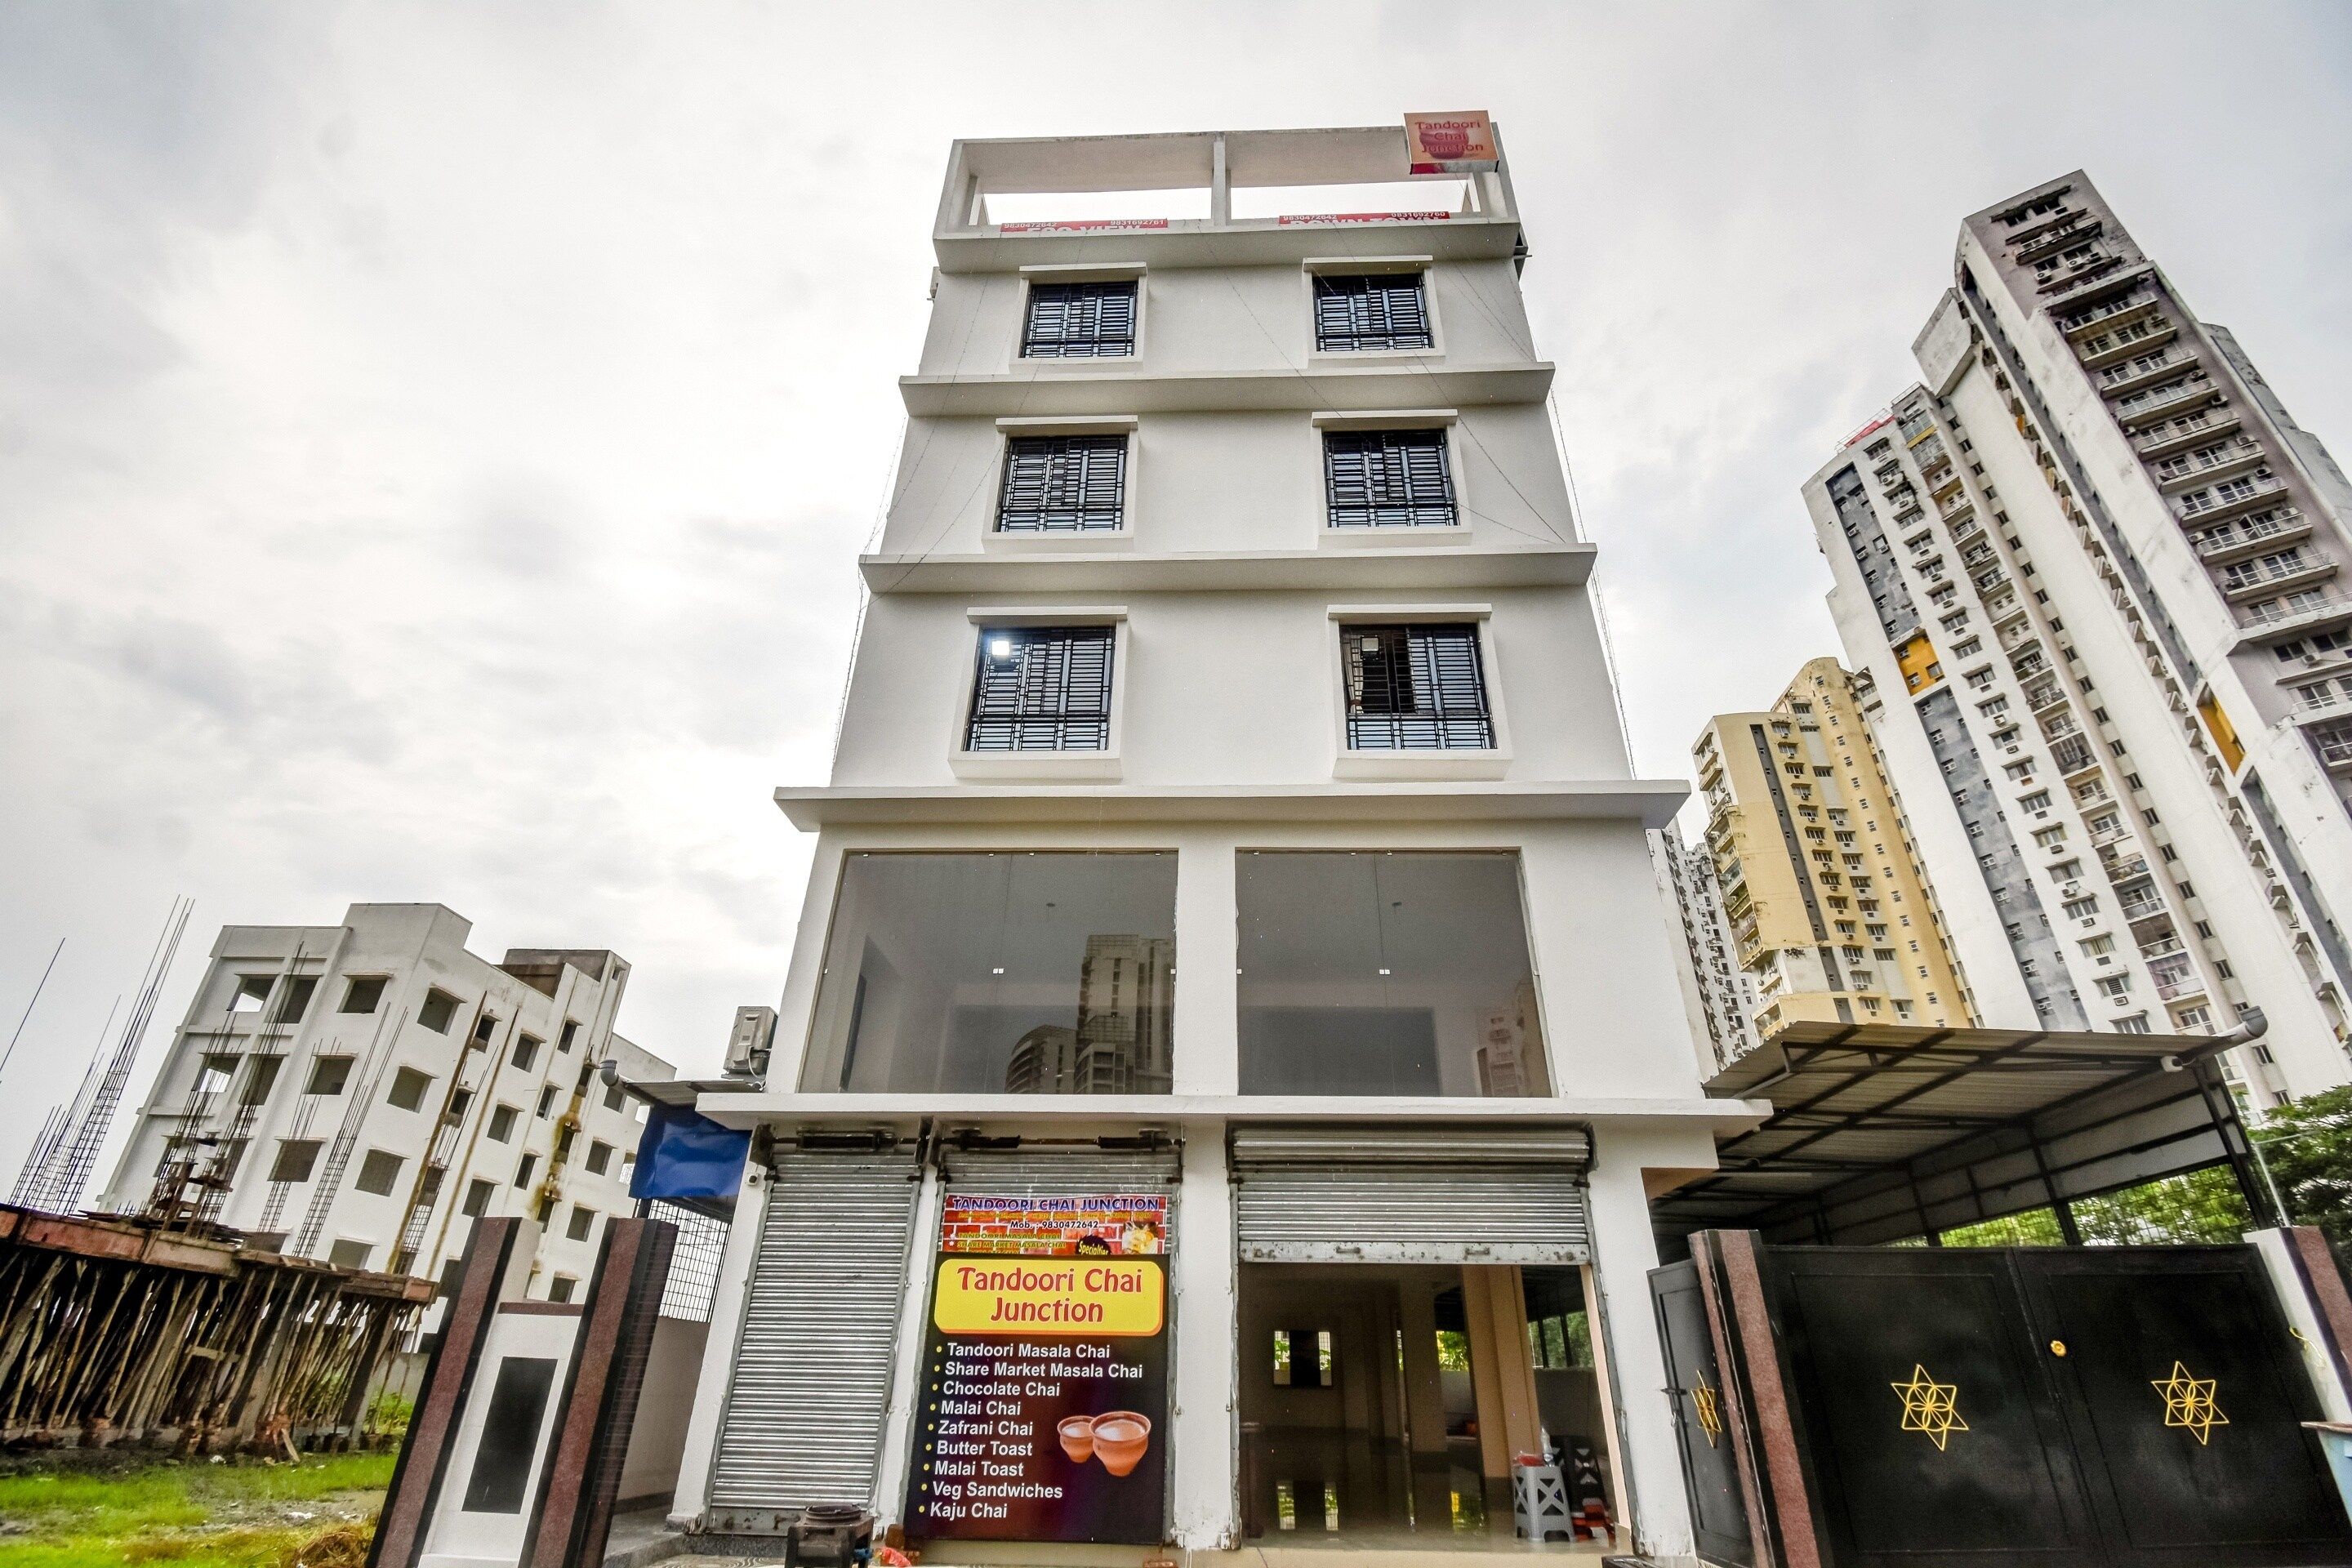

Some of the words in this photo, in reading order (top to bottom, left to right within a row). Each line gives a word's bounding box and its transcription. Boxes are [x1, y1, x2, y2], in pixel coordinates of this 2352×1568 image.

[1415, 120, 1481, 130] Tandoori
[1434, 132, 1467, 140] Chai
[1422, 143, 1484, 153] Junction
[953, 1198, 1034, 1211] TANDOORI
[1039, 1199, 1076, 1211] CHAI
[1080, 1198, 1159, 1211] JUNCTION
[1010, 1221, 1033, 1229] Mob.
[1042, 1220, 1098, 1229] 9830472642
[957, 1267, 1075, 1293] Tandoori
[1085, 1268, 1143, 1293] Chai
[991, 1297, 1103, 1323] Junction
[947, 1343, 1013, 1357] Tandoori
[1018, 1343, 1071, 1357] Masala
[1076, 1344, 1111, 1358] Chai
[945, 1361, 989, 1376] Share
[994, 1362, 1045, 1377] Market
[1050, 1363, 1103, 1378] Masala
[1108, 1364, 1143, 1378] Chai
[942, 1381, 1021, 1396] Chocolate
[1026, 1382, 1060, 1396] Chai
[941, 1401, 982, 1415] Malai
[987, 1401, 1021, 1415] Chai
[938, 1420, 993, 1435] Zafrani
[998, 1421, 1033, 1436] Chai
[937, 1441, 986, 1455] Butter
[990, 1441, 1032, 1456] Toast
[934, 1461, 976, 1477] Malai
[981, 1461, 1024, 1477] Toast
[933, 1481, 961, 1499] Veg
[967, 1481, 1062, 1498] Sandwiches
[929, 1502, 966, 1521] Kaju
[971, 1503, 1007, 1518] Chai
